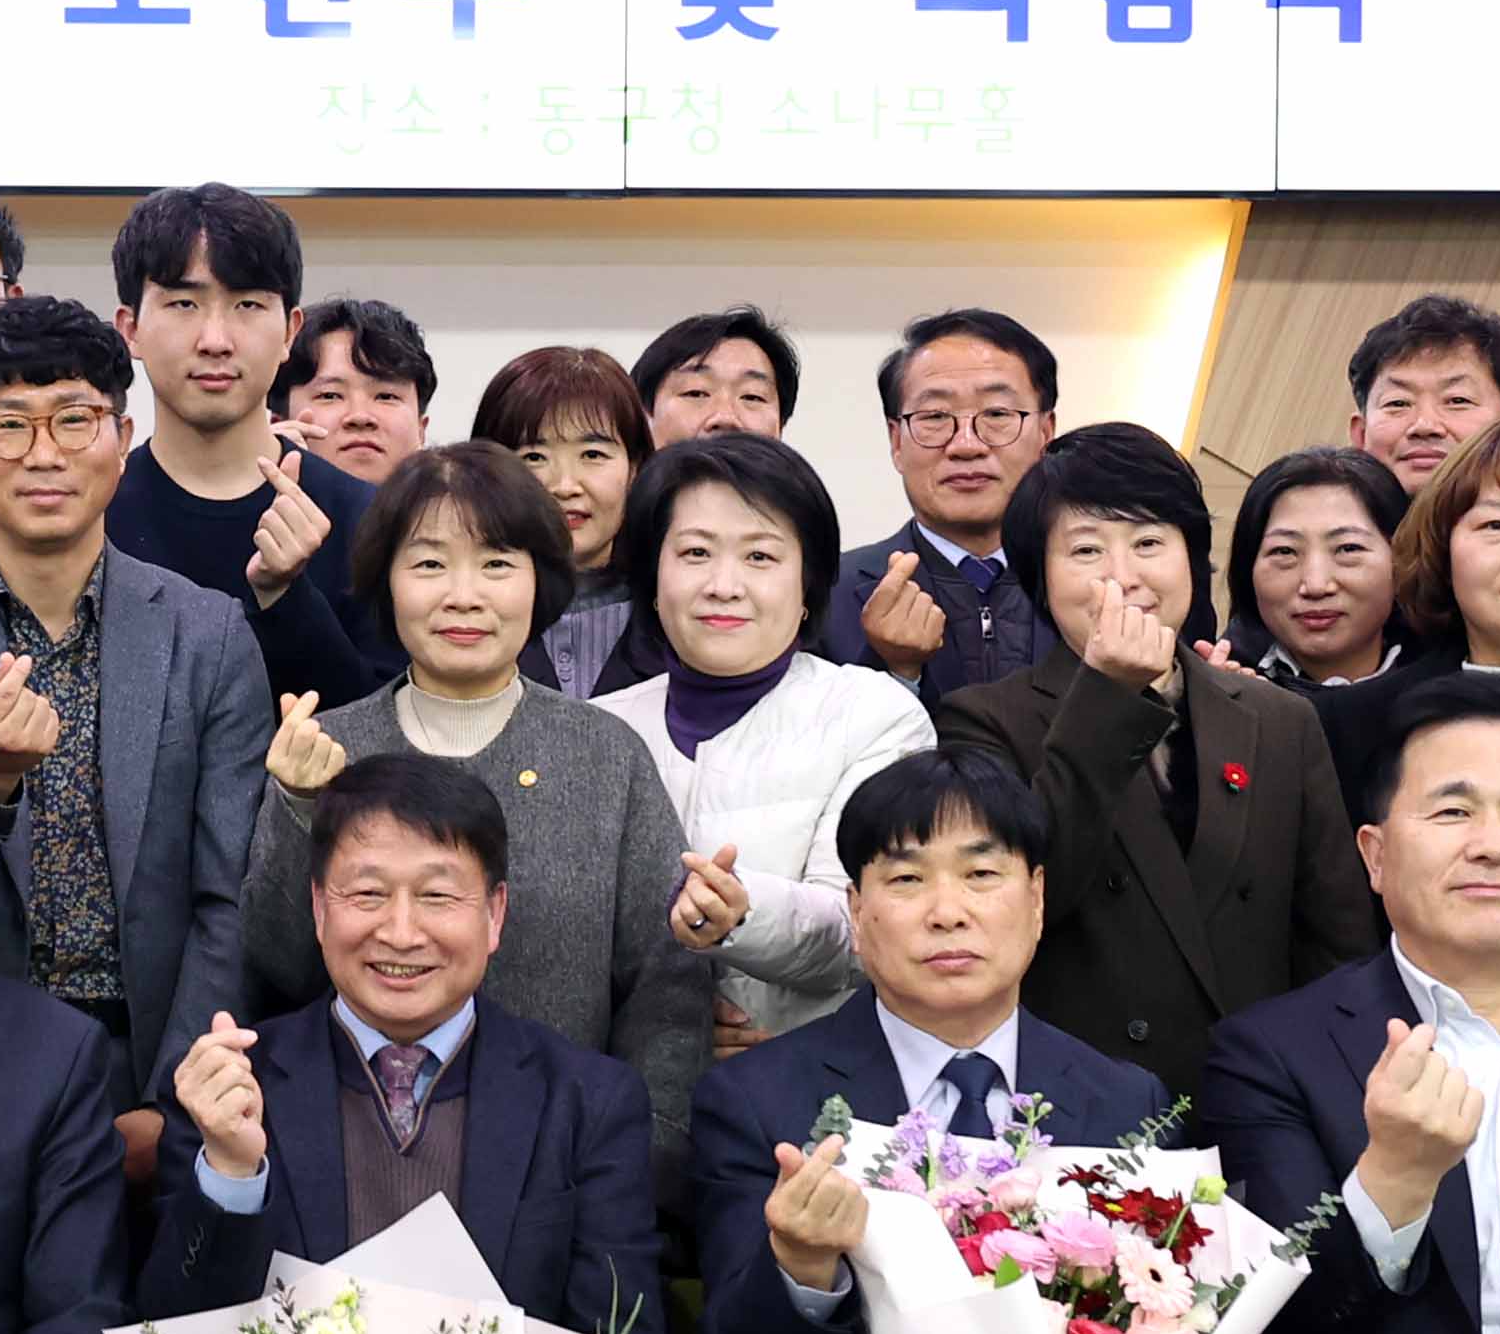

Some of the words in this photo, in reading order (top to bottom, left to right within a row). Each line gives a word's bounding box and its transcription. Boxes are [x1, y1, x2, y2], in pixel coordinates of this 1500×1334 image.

[316, 81, 445, 155] 장소
[528, 80, 725, 155] 동구청
[758, 80, 1025, 155] 소나무홀
